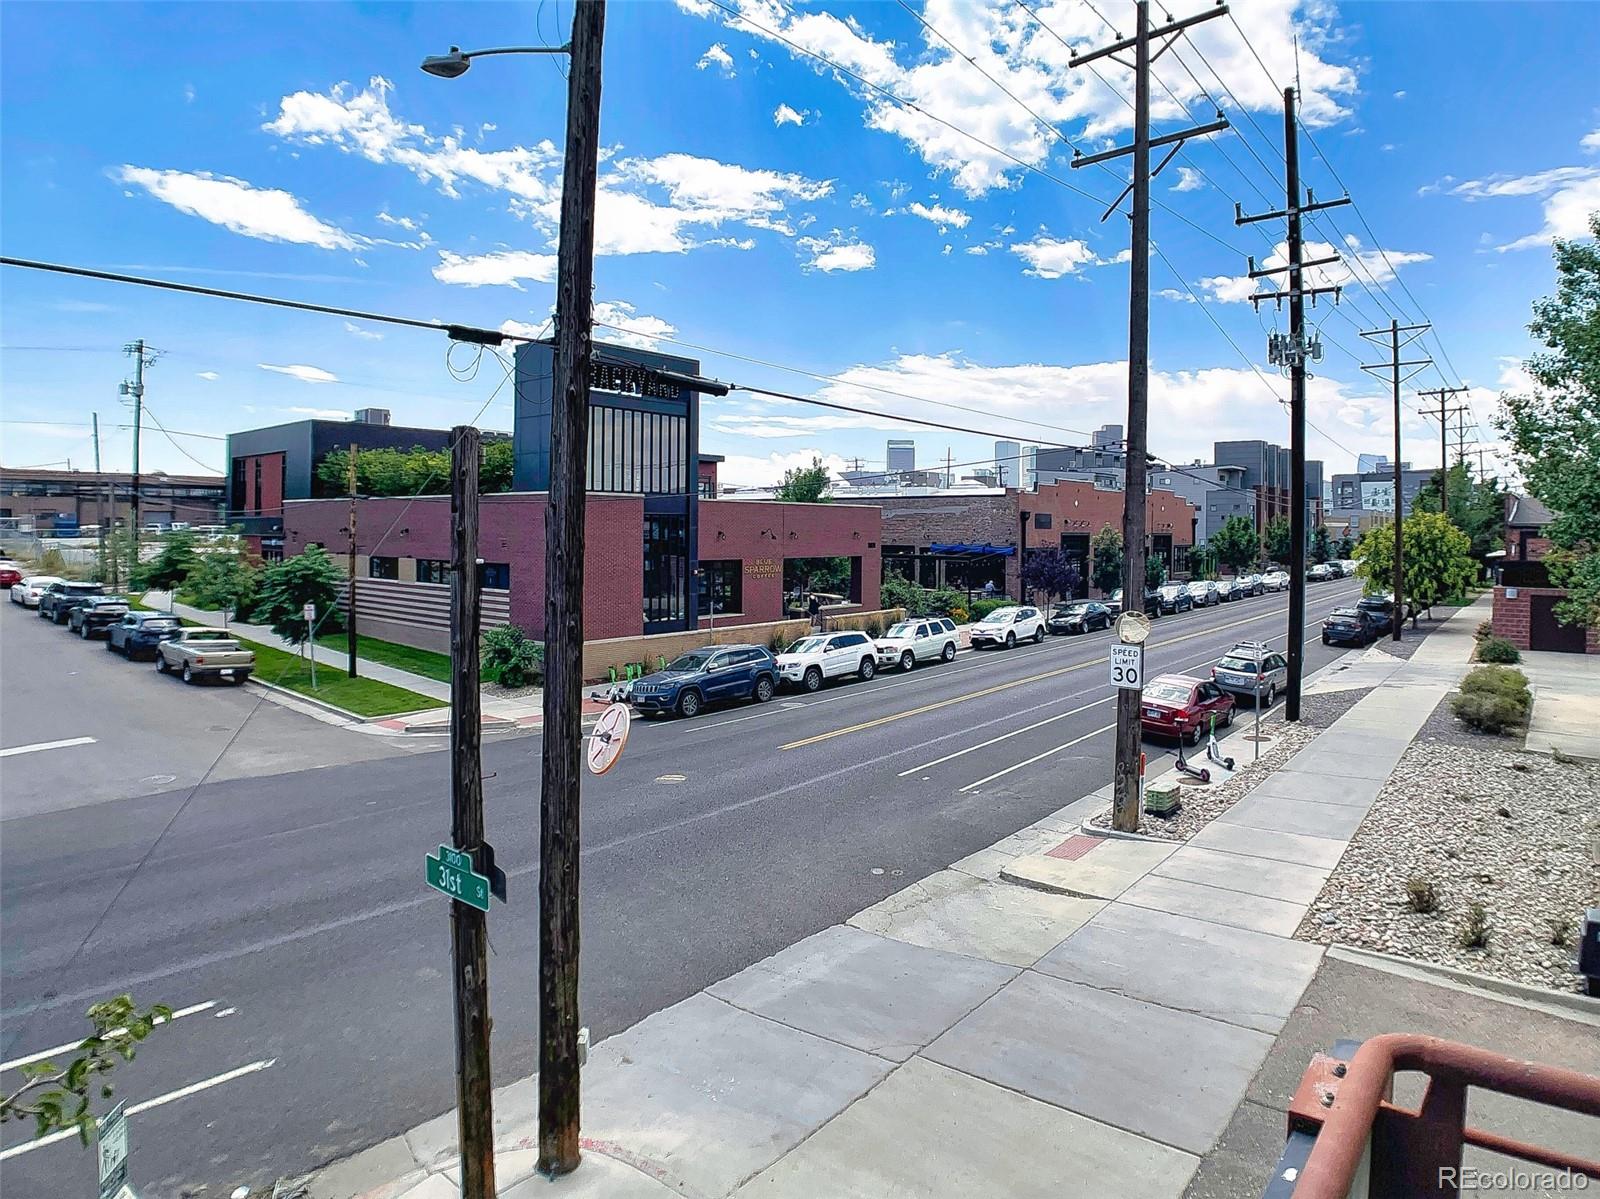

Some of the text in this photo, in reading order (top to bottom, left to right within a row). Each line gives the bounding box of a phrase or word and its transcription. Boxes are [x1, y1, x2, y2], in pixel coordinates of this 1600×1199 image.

[744, 565, 782, 574] SPARROW
[1112, 648, 1139, 658] SPEED
[1114, 658, 1136, 666] LIMIT
[1112, 666, 1138, 684] 30
[438, 865, 462, 895] 31st
